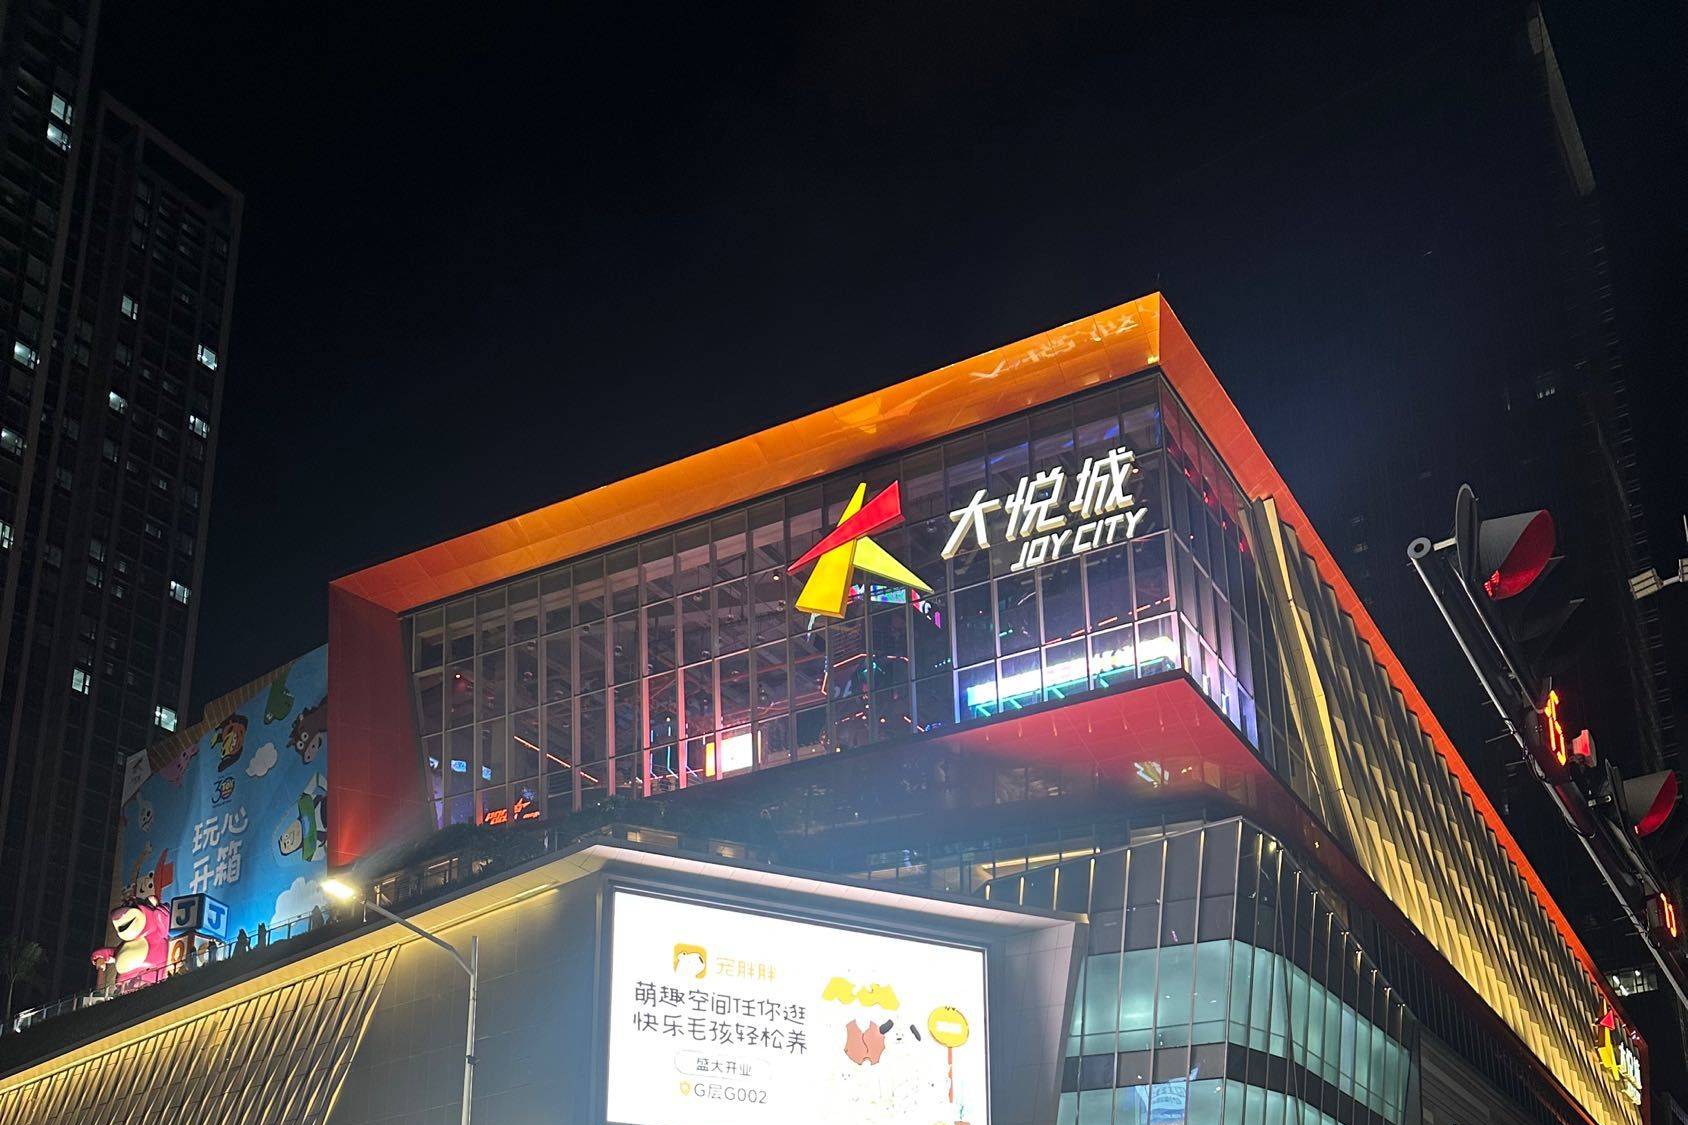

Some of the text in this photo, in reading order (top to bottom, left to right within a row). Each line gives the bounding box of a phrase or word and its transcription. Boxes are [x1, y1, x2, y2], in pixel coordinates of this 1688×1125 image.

[941, 446, 1135, 560] 大悦城
[1010, 507, 1148, 572] JOY CITY
[192, 805, 248, 854] 玩心
[190, 839, 243, 895] 开箱
[634, 980, 807, 1026] 萌趣空间任你逛
[633, 1011, 808, 1055] 快乐毛孩轻松养
[696, 1058, 752, 1077] 盛大开业
[694, 1083, 767, 1104] G层G002
